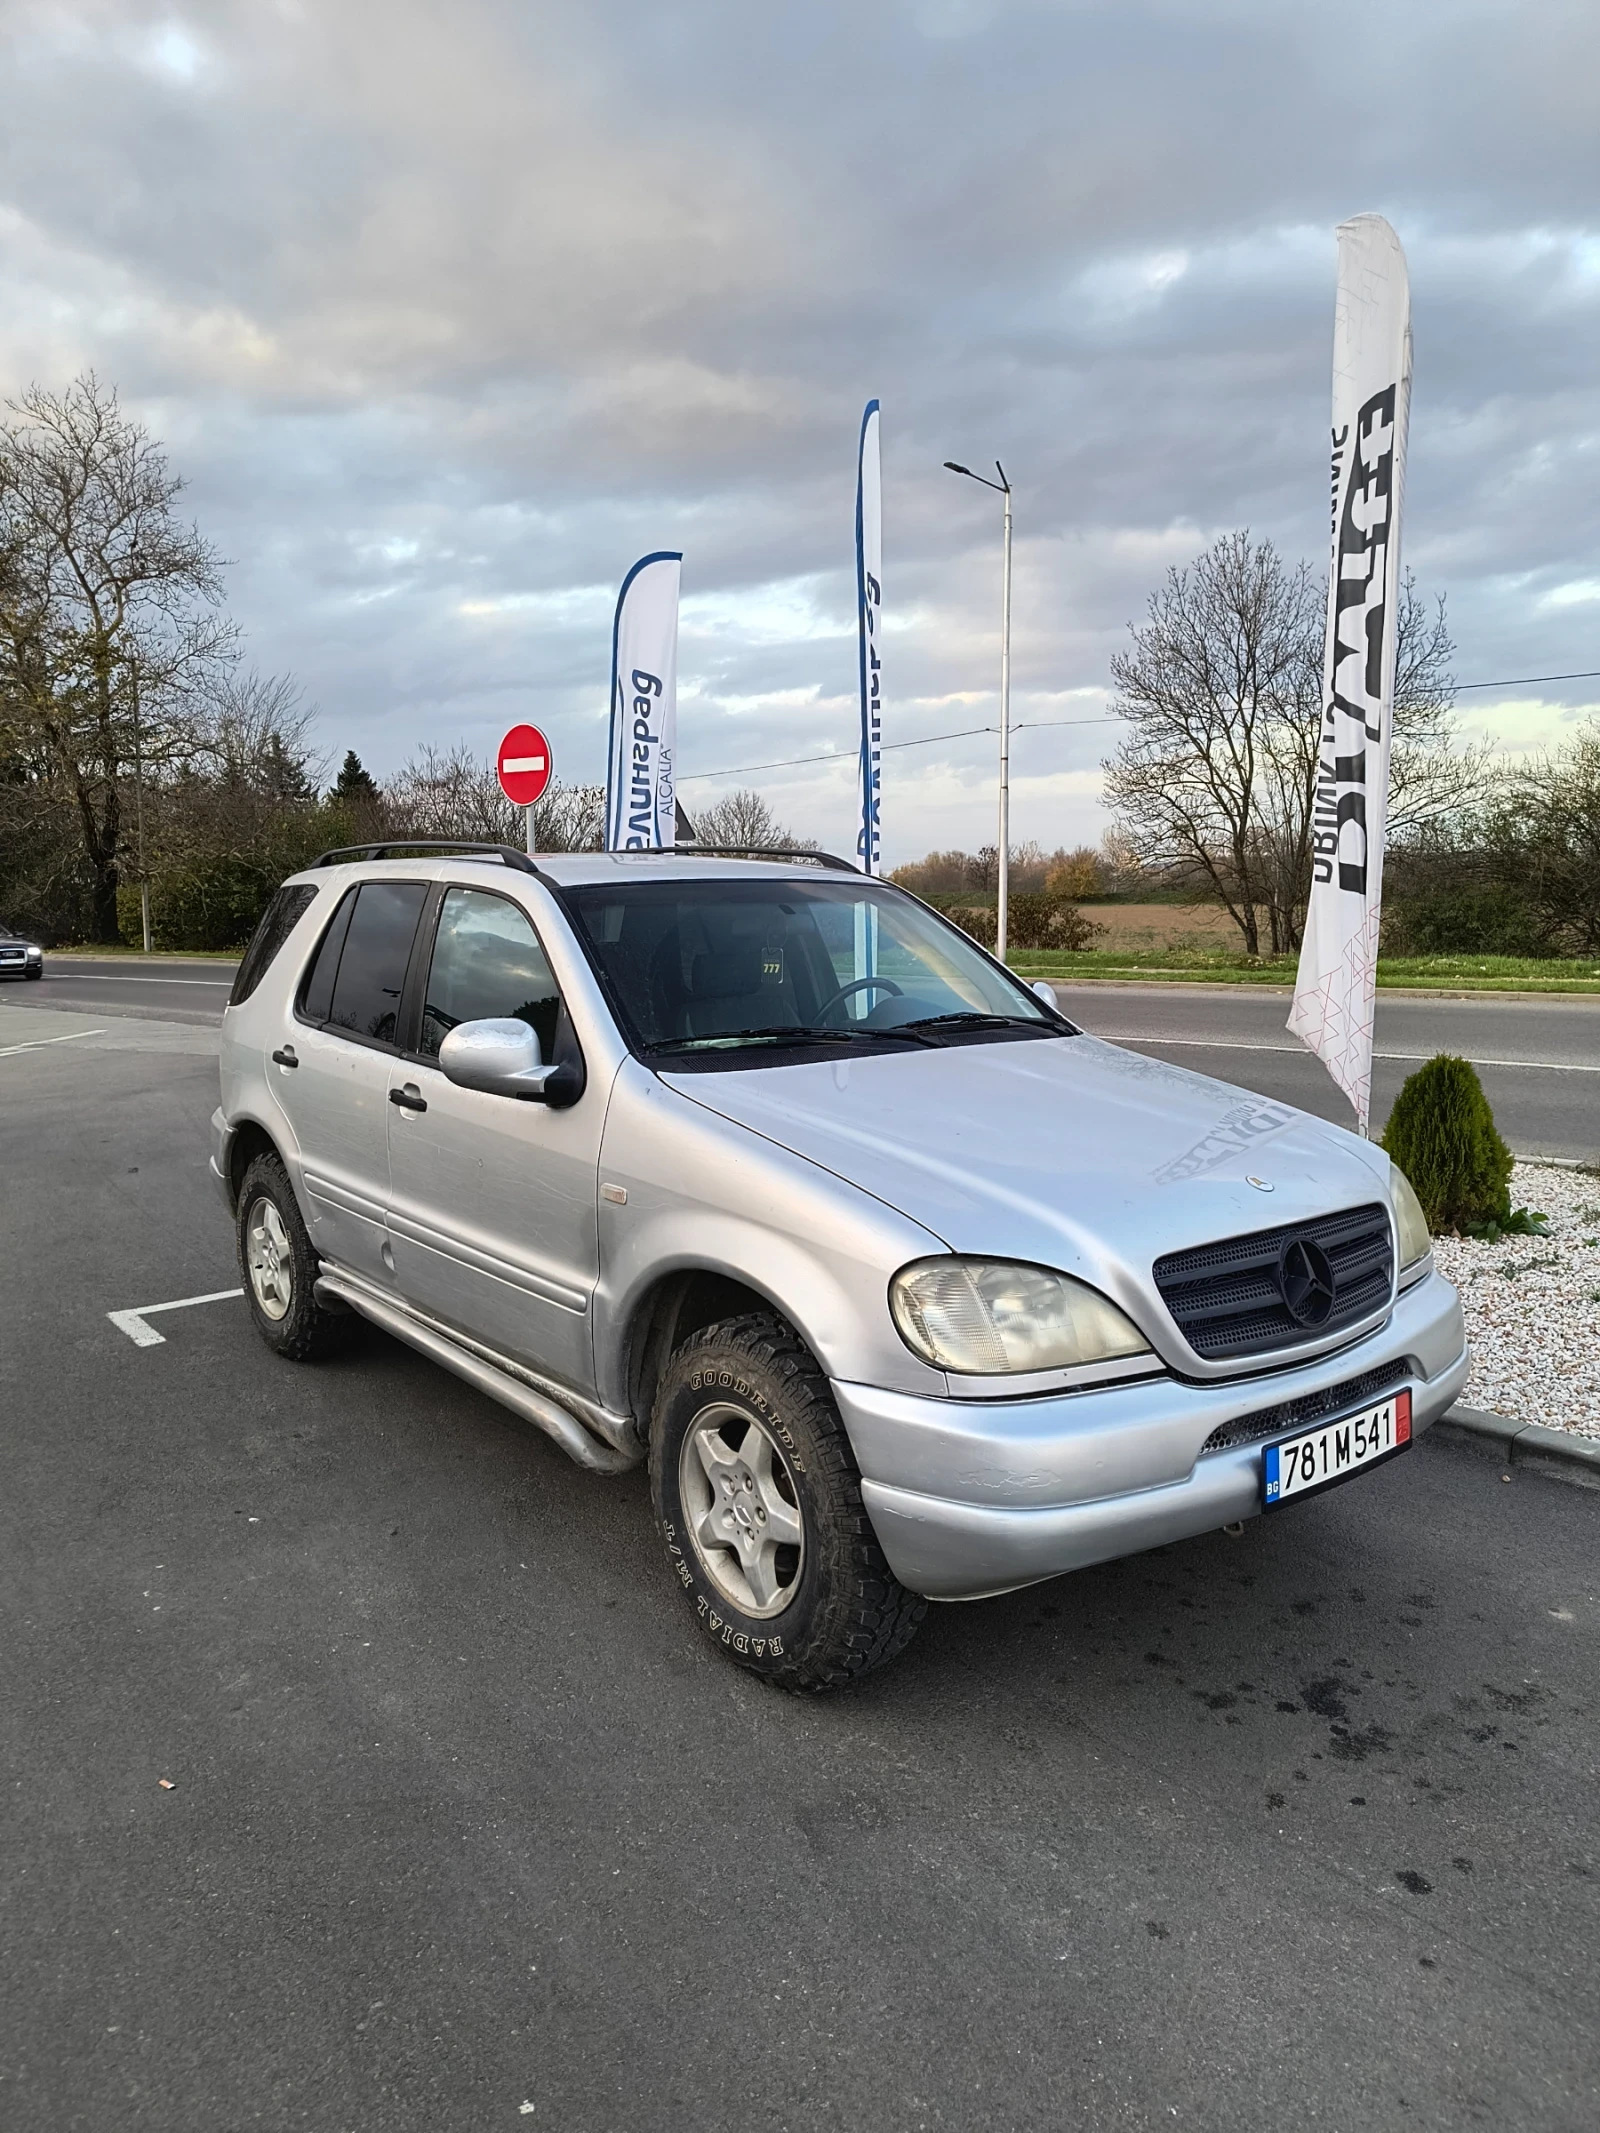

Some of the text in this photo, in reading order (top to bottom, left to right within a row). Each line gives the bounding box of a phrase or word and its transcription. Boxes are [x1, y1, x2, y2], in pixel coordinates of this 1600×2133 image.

[659, 748, 674, 817] ALCALIA
[763, 963, 780, 974] 777
[690, 1369, 807, 1473] GOODRIDE
[1267, 1481, 1279, 1496] BG
[663, 1520, 784, 1657] RADIAL M/T
